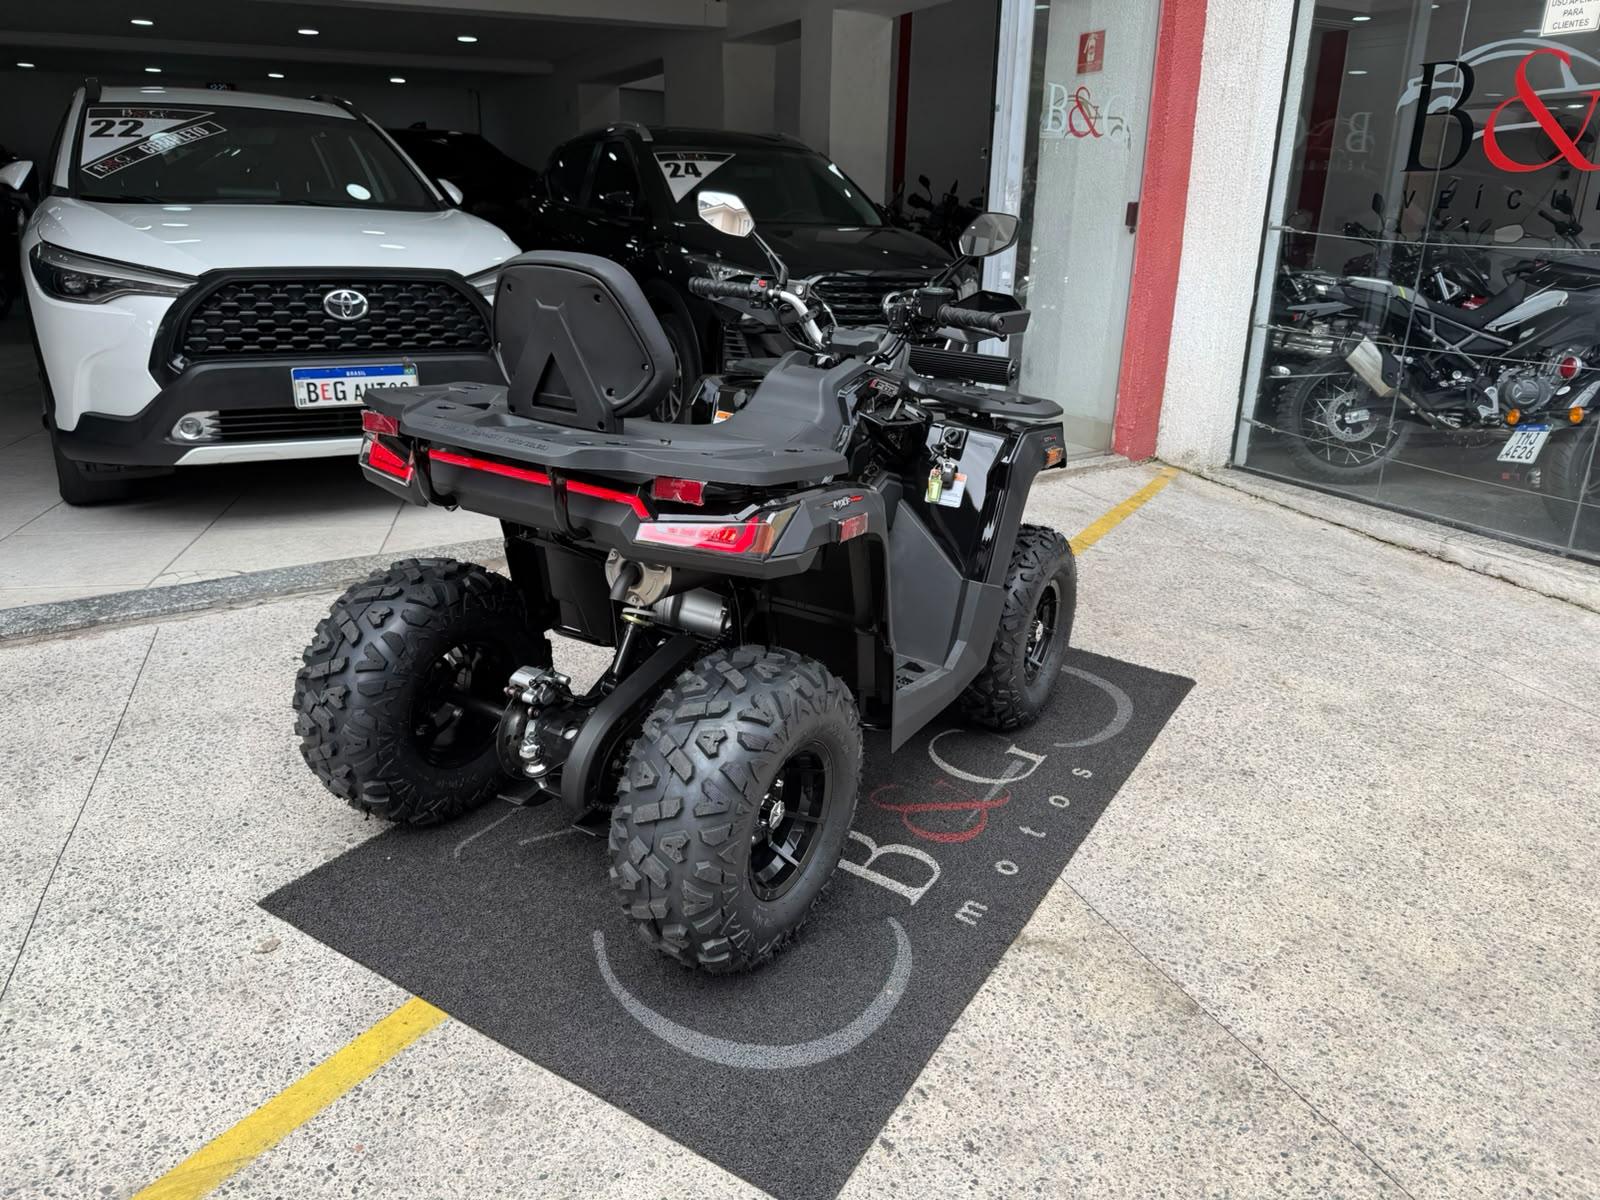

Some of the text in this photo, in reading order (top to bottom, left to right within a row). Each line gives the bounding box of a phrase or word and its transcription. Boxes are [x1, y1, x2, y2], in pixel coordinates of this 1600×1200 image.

[1562, 8, 1584, 17] PARA
[1552, 18, 1590, 30] CLIENTES
[89, 119, 144, 138] 22
[663, 161, 702, 179] 24
[306, 380, 348, 403] BEG
[1515, 432, 1541, 446] TMJ
